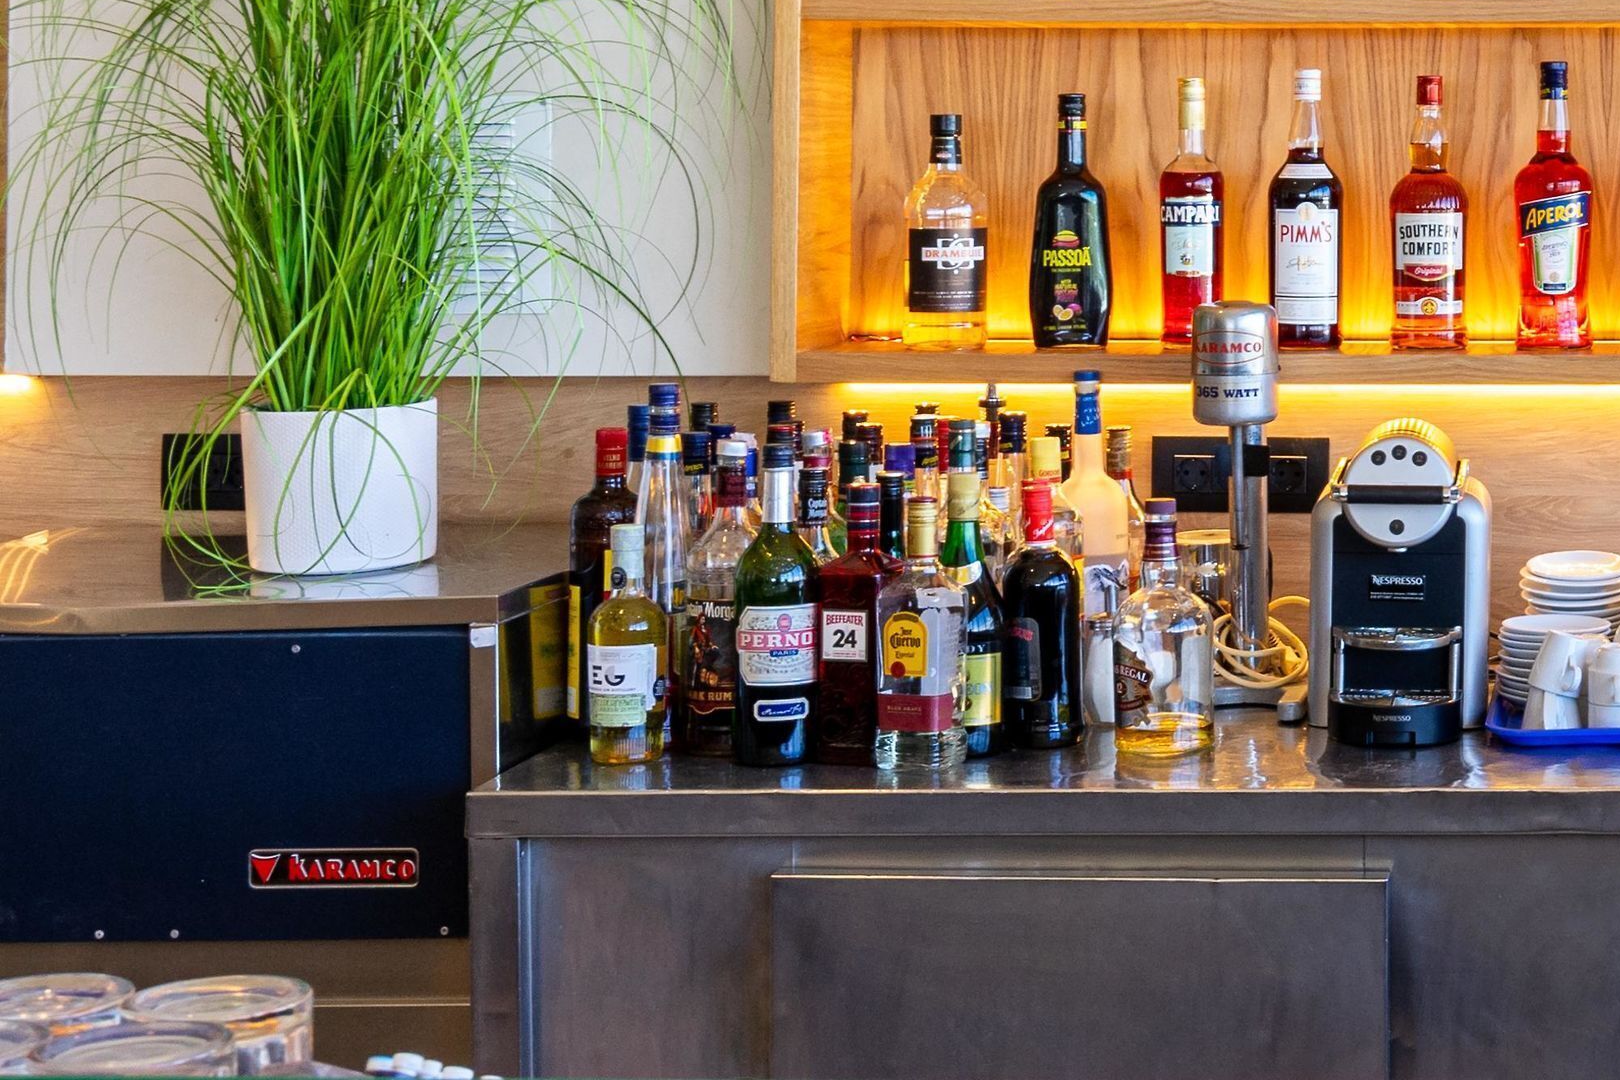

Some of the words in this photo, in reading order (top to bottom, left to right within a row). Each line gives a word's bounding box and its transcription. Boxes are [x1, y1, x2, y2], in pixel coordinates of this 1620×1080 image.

[1161, 204, 1220, 223] CAMPARI
[1526, 201, 1584, 231] APEROL
[1281, 222, 1332, 242] PIMM'S
[1399, 224, 1459, 239] SOUTHERN
[1223, 388, 1260, 398] WATT
[1371, 574, 1424, 587] NESPRESSO
[703, 601, 735, 621] Morga
[825, 614, 863, 627] BEEFEATER
[740, 631, 813, 648] PERNO
[832, 629, 857, 649] 24
[890, 633, 921, 649] Cuervo
[1119, 665, 1148, 683] REGAL
[707, 691, 733, 701] RUM
[1372, 713, 1412, 722] NESPRESSO
[288, 853, 417, 882] KARAMCO
